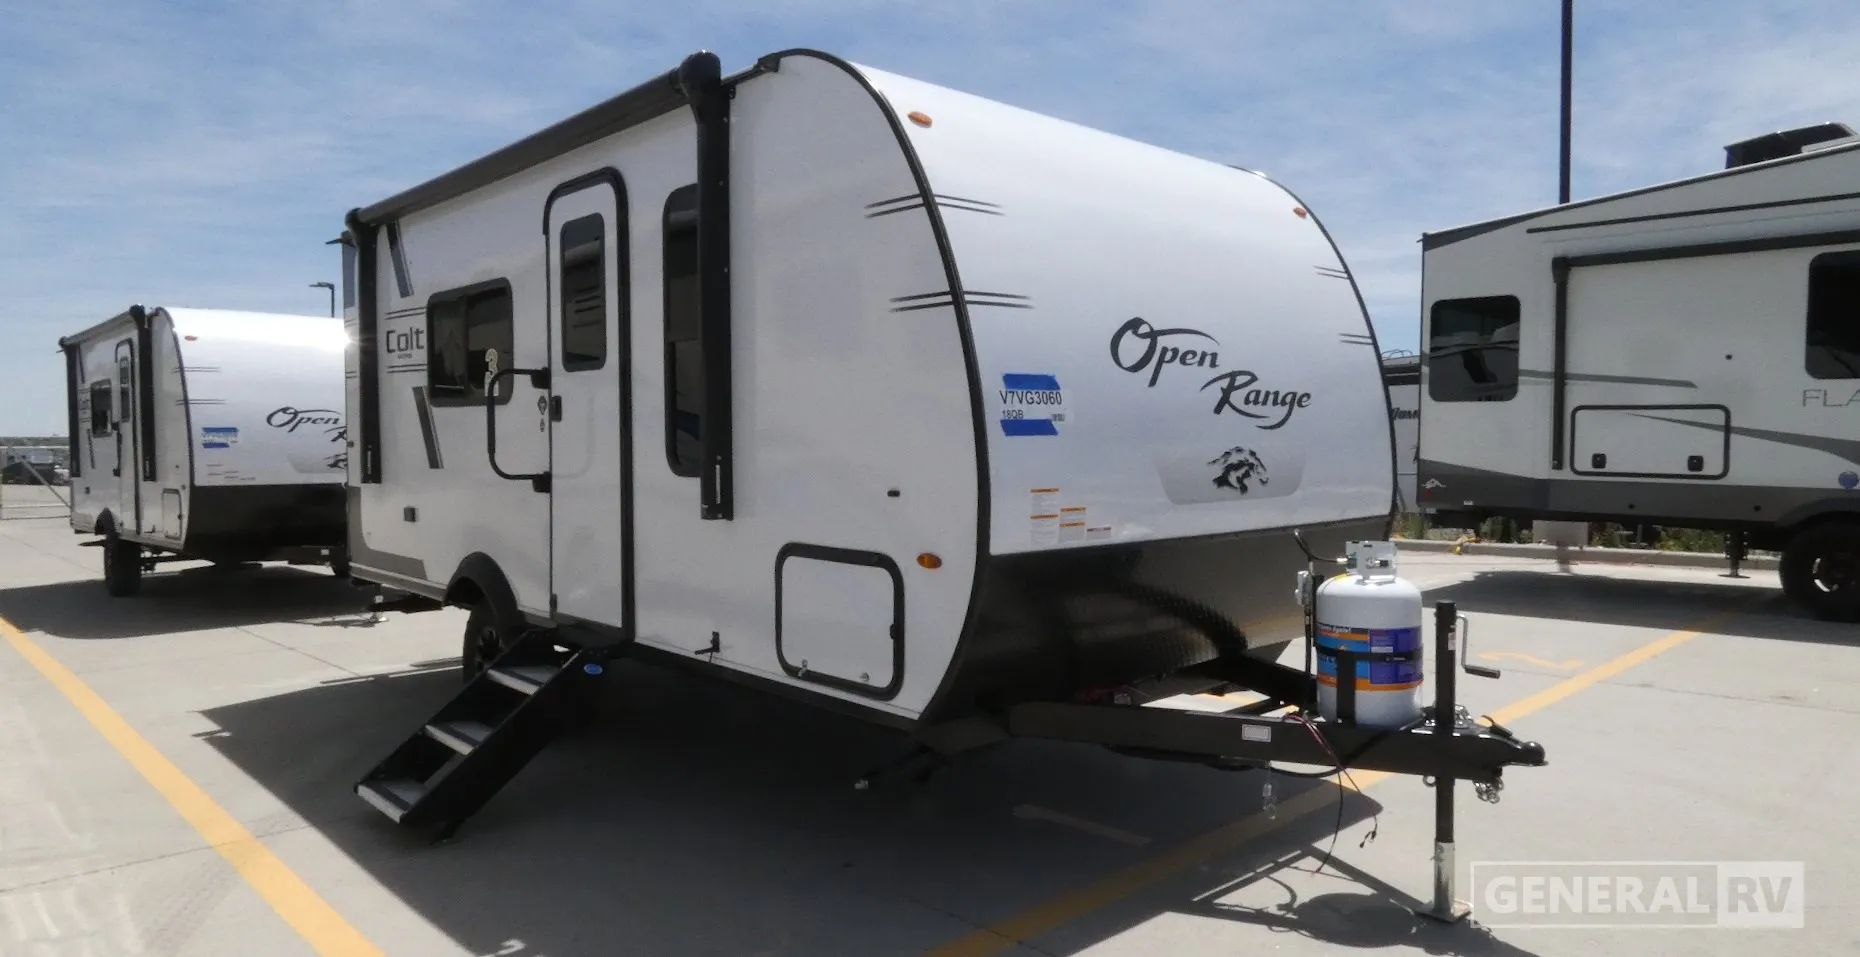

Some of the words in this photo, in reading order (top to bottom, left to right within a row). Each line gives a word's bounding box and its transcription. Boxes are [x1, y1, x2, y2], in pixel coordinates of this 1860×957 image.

[386, 326, 425, 353] Colt
[1109, 316, 1220, 388] Open
[999, 389, 1063, 405] V7VG3060
[1200, 370, 1311, 430] Range
[266, 406, 342, 433] Open
